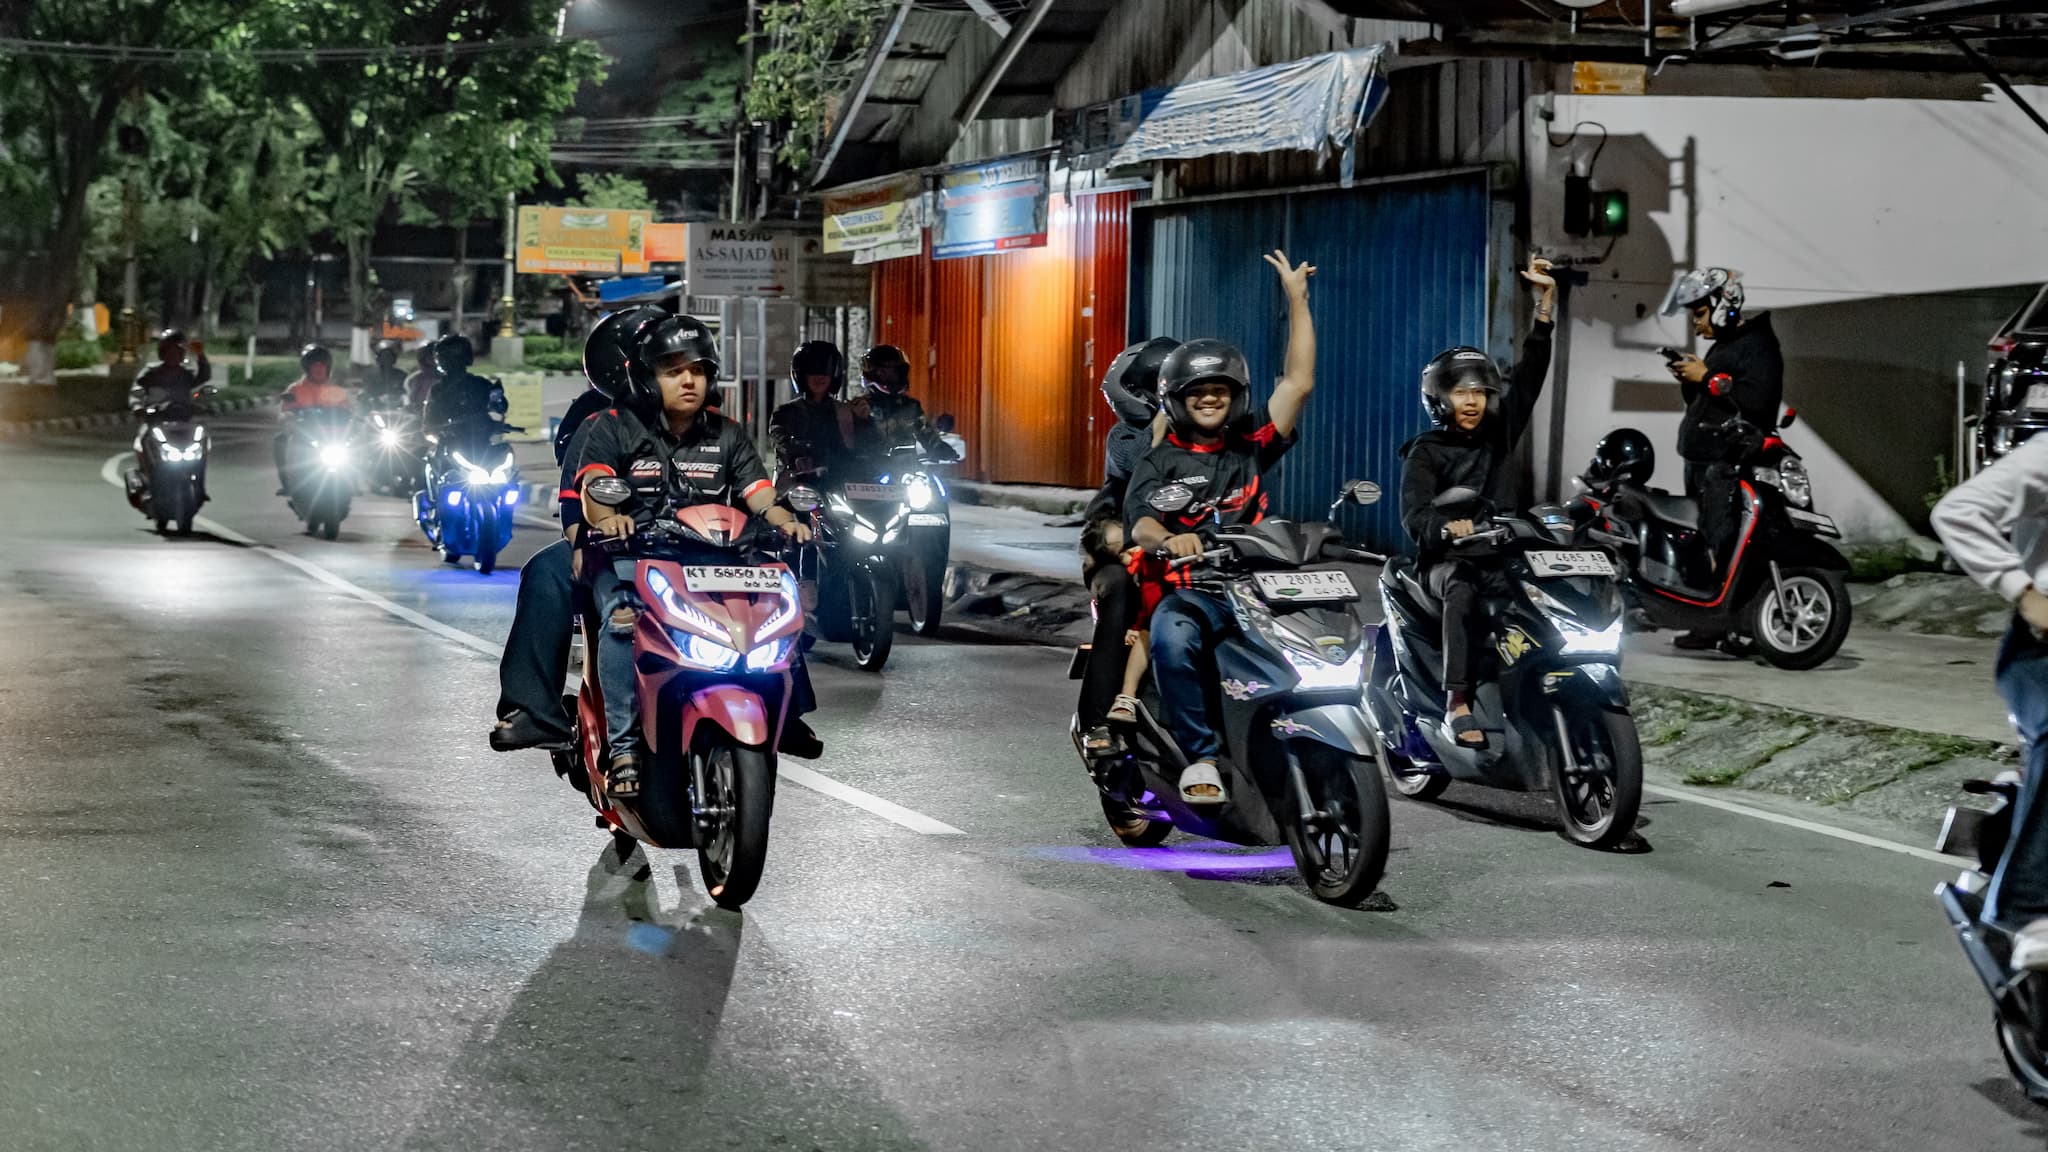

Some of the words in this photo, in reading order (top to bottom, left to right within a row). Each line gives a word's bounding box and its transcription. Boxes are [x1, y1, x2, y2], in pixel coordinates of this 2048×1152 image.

[696, 247, 789, 263] AS-SAJADAH
[1530, 552, 1548, 566] KT
[686, 567, 707, 578] KT
[758, 569, 780, 580] AZ
[1259, 575, 1279, 586] KT
[1286, 574, 1322, 585] 2893
[1326, 573, 1347, 584] KC
